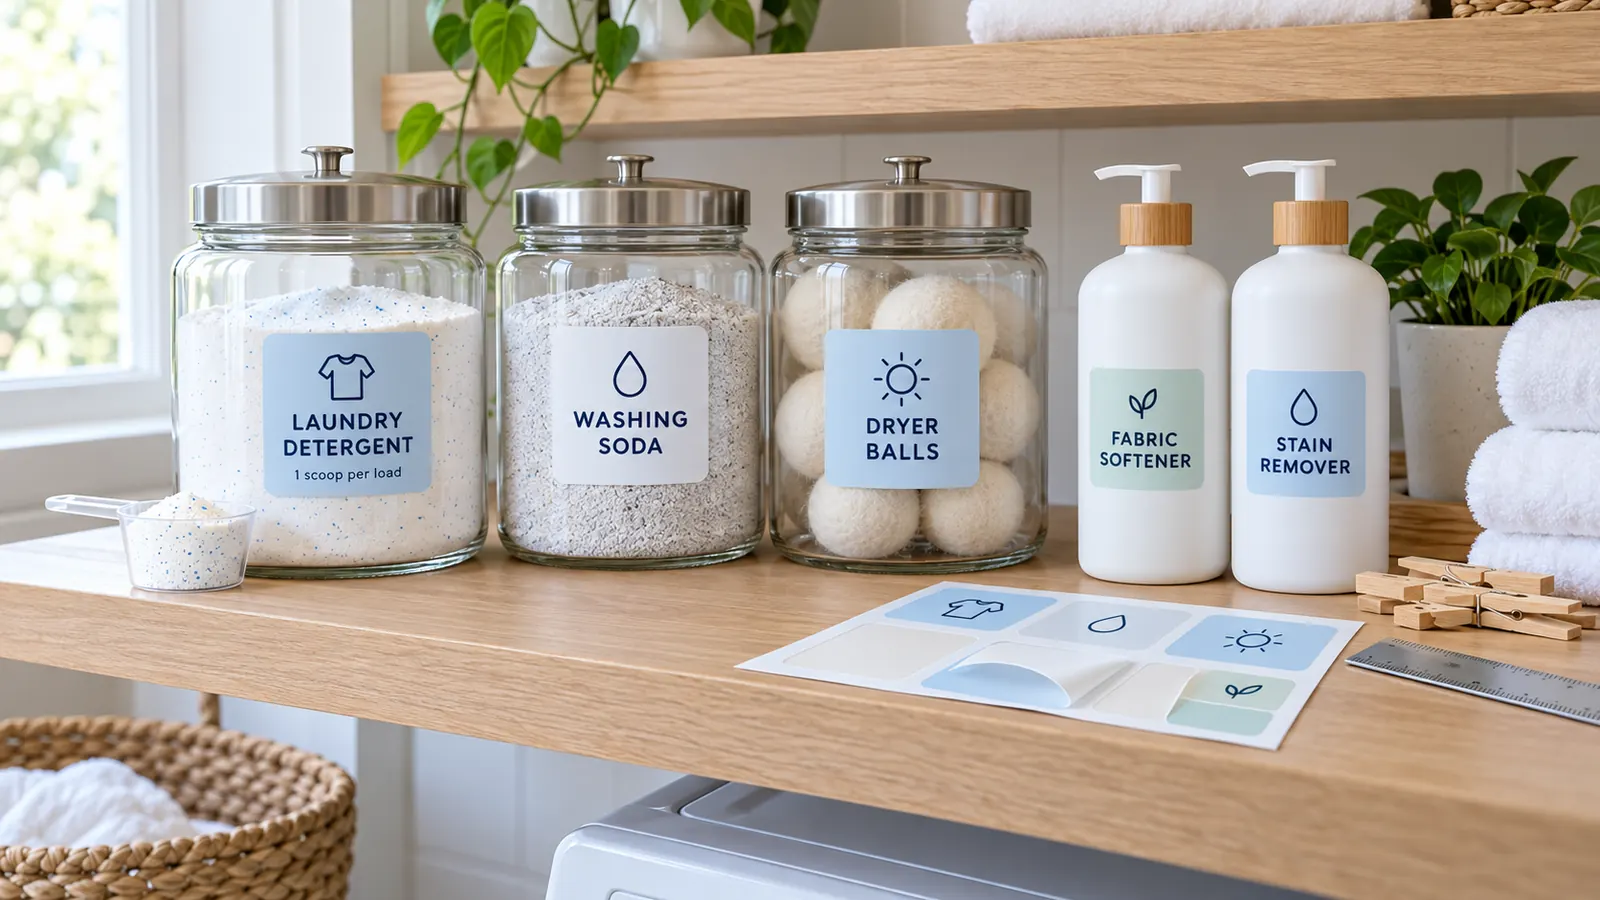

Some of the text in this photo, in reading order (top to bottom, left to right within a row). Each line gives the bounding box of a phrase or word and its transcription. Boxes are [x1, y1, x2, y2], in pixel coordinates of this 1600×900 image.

[292, 411, 403, 431] LAUNDRY
[573, 410, 688, 428] WASHING
[866, 417, 939, 435] DRYER
[283, 436, 414, 457] DETERGENT
[598, 437, 663, 455] SODA
[1112, 430, 1178, 447] FABRIC
[1276, 436, 1333, 453] STAIN
[866, 442, 939, 461] BALLS
[1100, 451, 1192, 469] SOFTENER
[294, 466, 402, 483] 1 scoop per load
[1260, 457, 1351, 475] REMOVER
